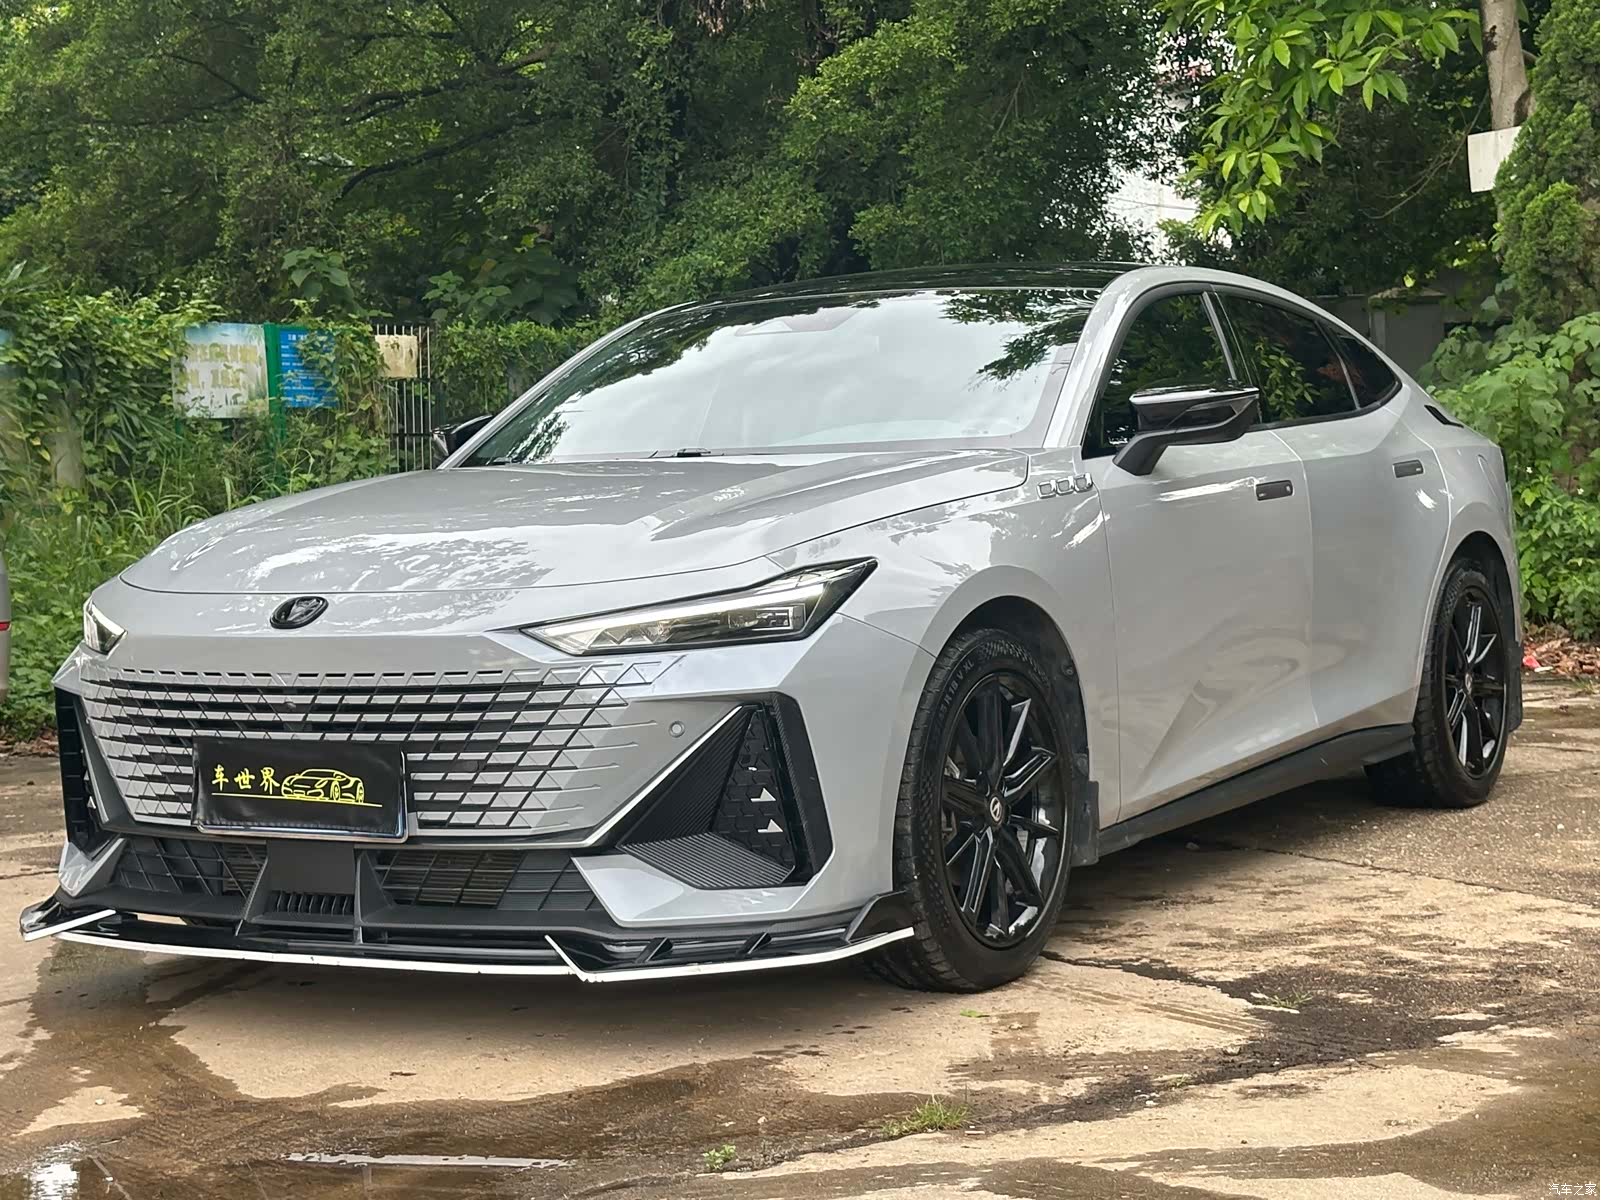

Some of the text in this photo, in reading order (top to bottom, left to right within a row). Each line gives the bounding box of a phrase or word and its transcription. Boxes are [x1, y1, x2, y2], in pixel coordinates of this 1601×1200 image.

[963, 659, 974, 673] XL
[212, 764, 280, 795] 车世界
